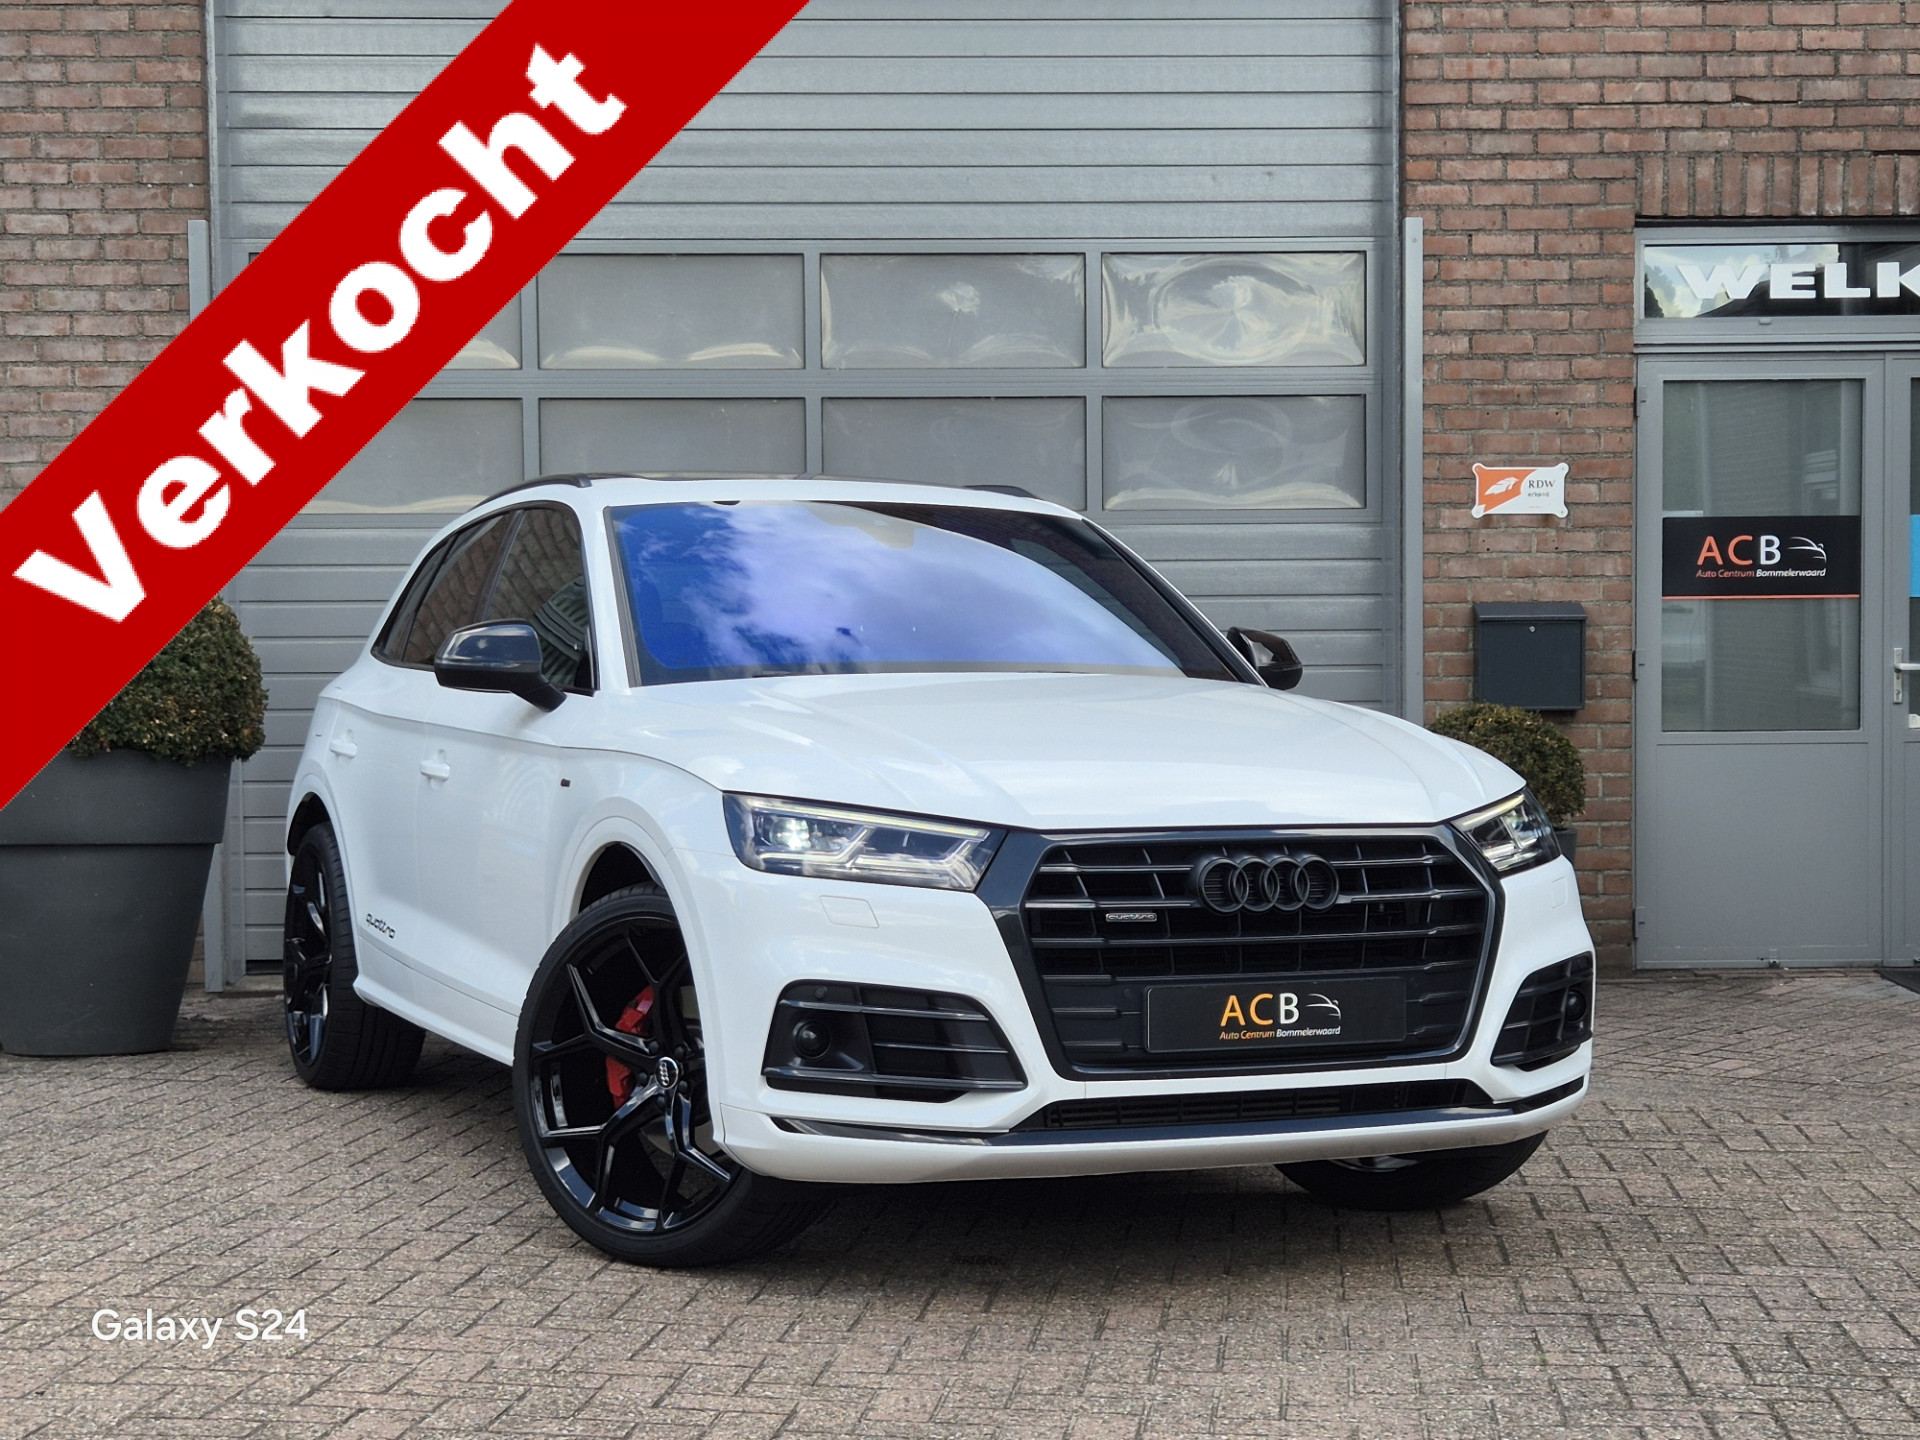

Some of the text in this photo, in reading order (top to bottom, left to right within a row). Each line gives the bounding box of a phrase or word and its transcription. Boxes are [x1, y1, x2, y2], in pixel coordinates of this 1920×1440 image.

[1528, 480, 1555, 489] RDW
[1697, 535, 1781, 566] ACB
[1696, 568, 1826, 578] Auto Centrum Bommelerwaard
[366, 913, 395, 938] quattro
[1220, 993, 1300, 1026] ACB
[1220, 1026, 1341, 1040] Auto Centrum Bommelerwaard
